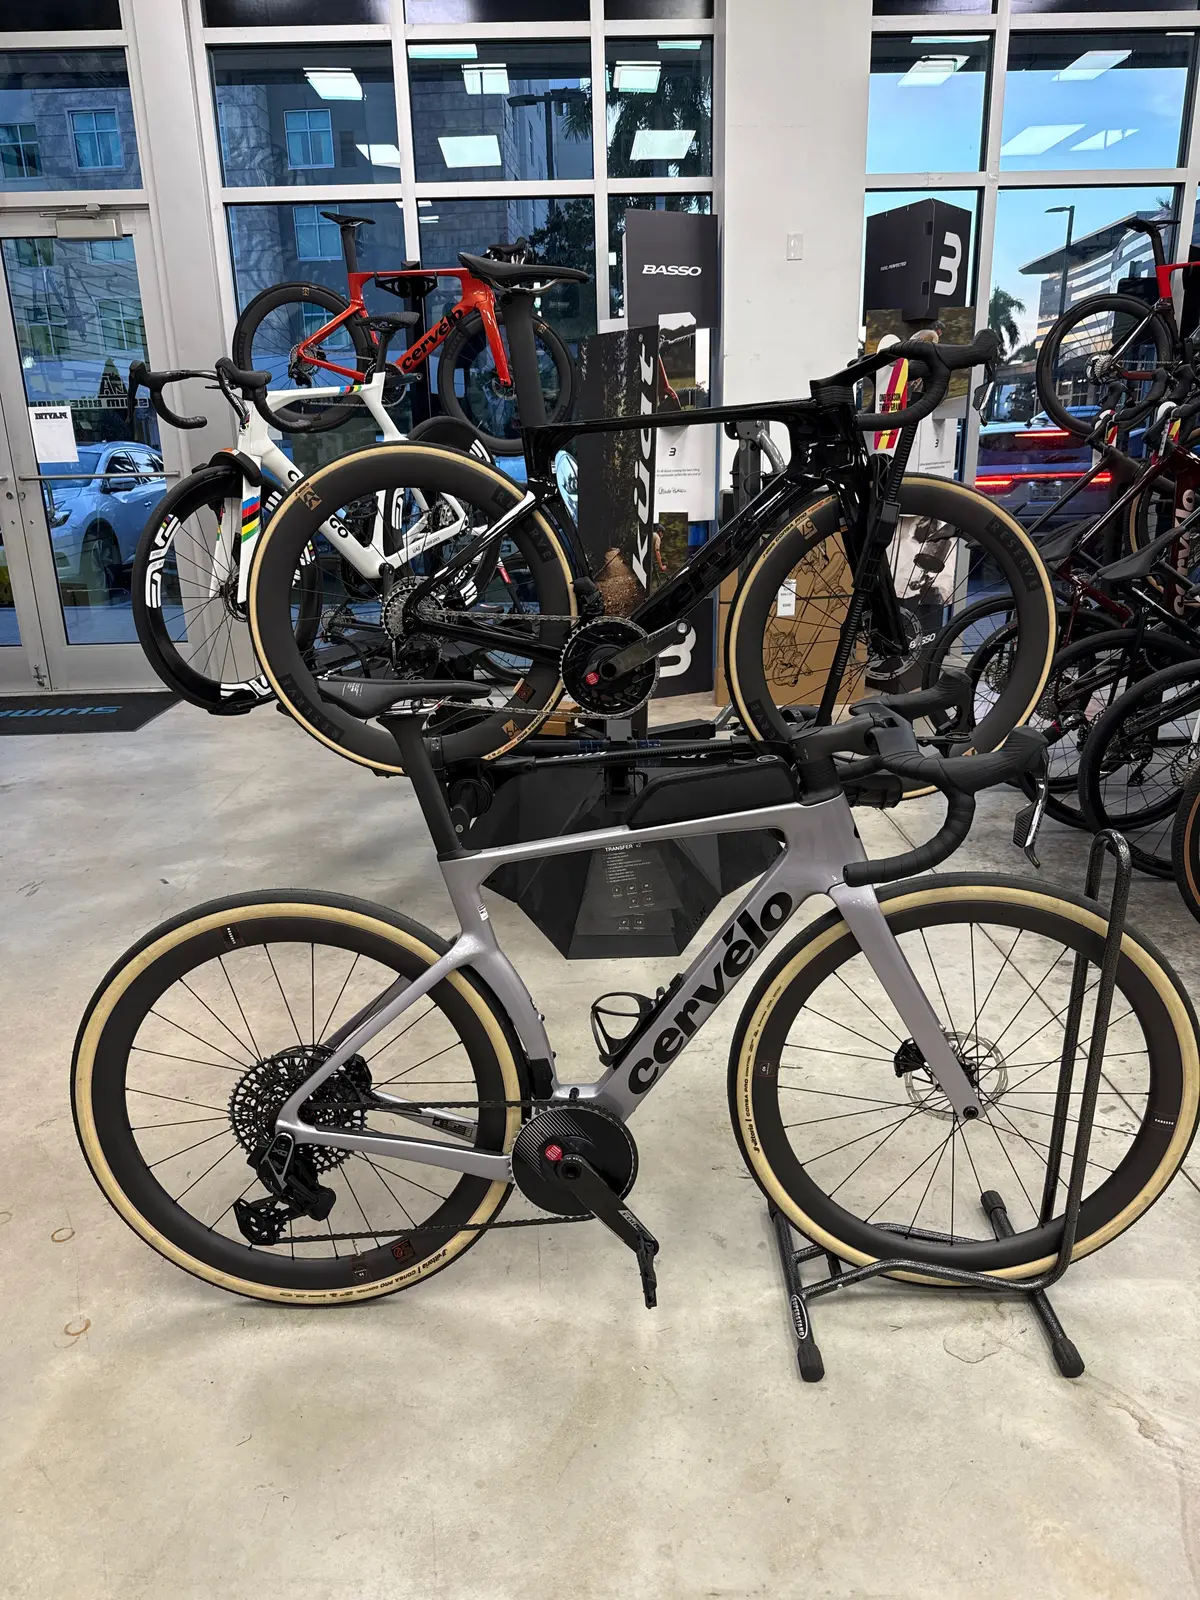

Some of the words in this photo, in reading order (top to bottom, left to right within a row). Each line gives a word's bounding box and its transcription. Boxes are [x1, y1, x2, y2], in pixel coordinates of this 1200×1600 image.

[642, 264, 702, 276] BASSO
[499, 490, 553, 559] REERVE
[991, 521, 1040, 588] RESERVE
[909, 633, 936, 649] BSSO
[628, 892, 792, 1095] cervélo
[422, 1253, 443, 1269] vittoria
[380, 1280, 394, 1288] PRO
[395, 1270, 417, 1282] CORSA
